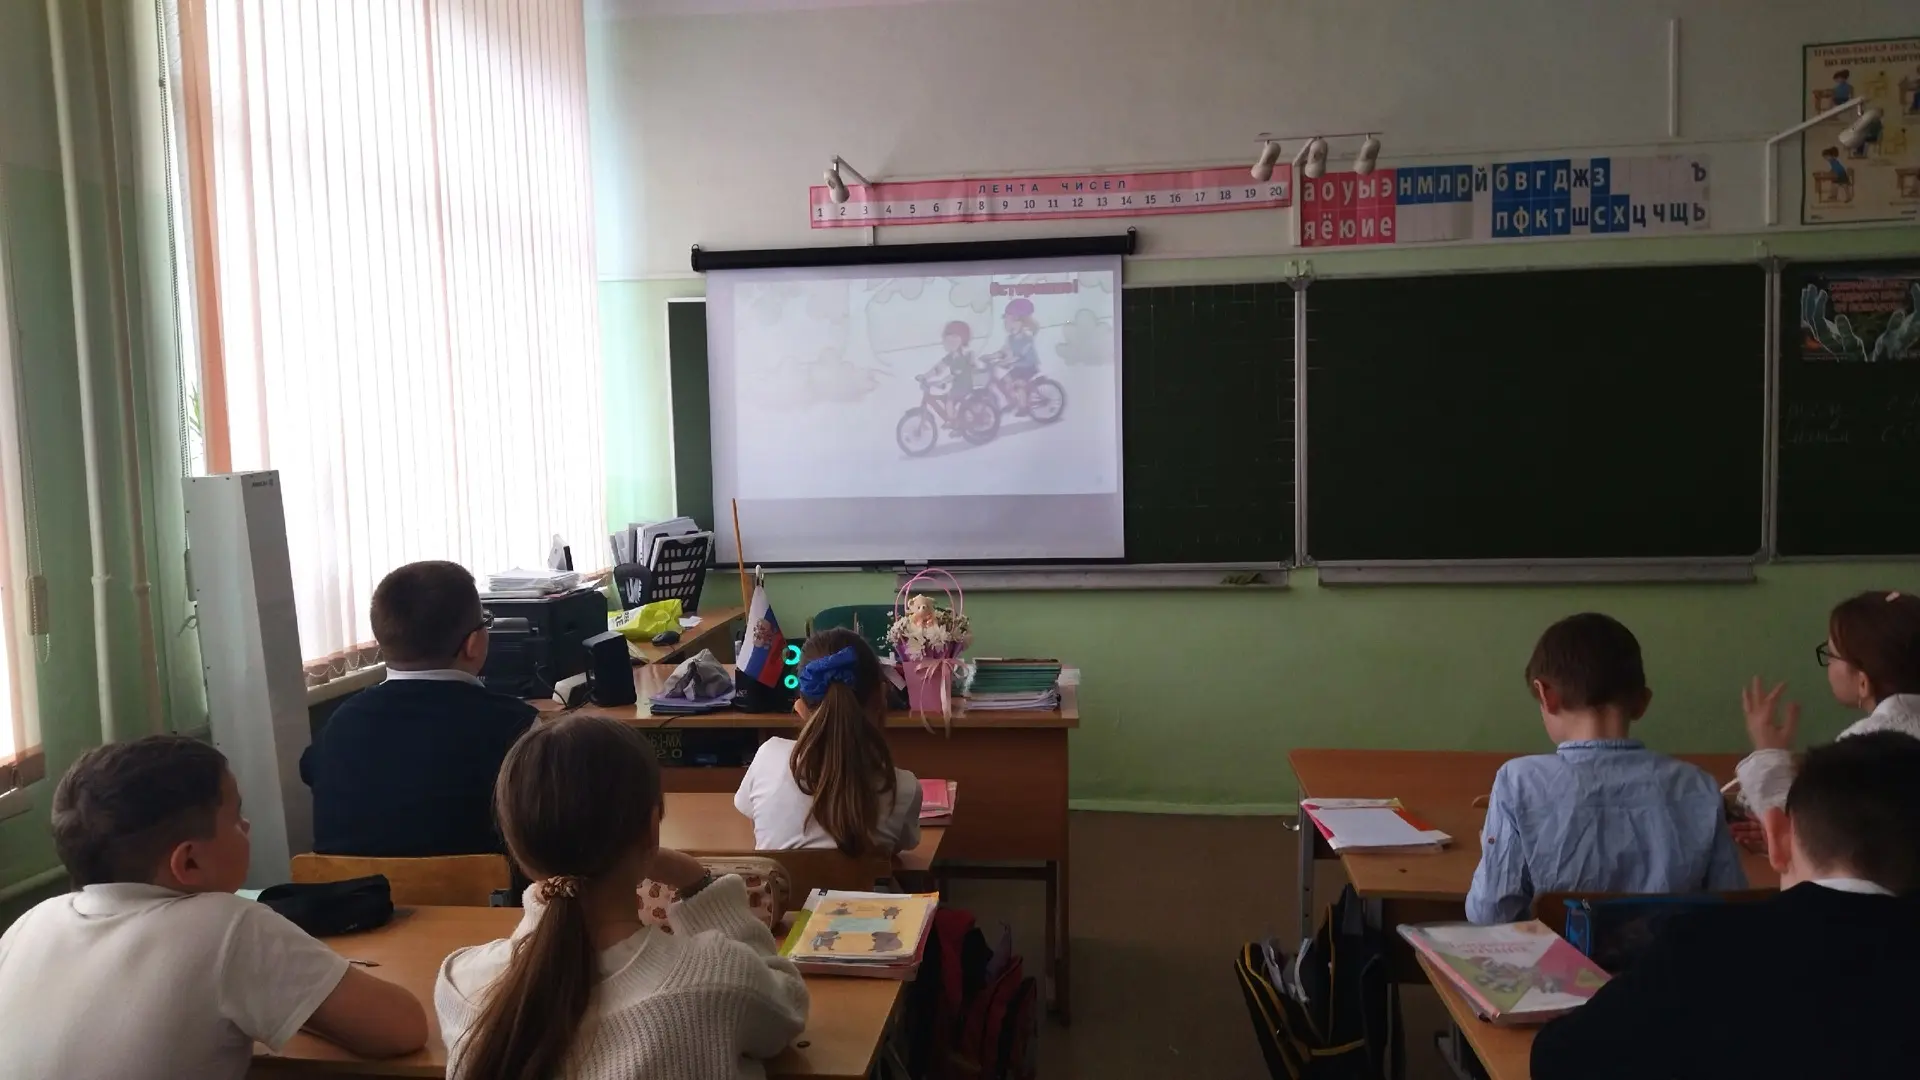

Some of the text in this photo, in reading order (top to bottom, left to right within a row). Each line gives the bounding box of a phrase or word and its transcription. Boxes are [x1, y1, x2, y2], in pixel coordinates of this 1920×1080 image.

[978, 181, 1126, 194] ЛЕНТА ЧИСЕЛ
[818, 186, 1282, 217] 1 2 3 4 5 6 7 8 9 10 11 12 13 14 15 16 17 18 19 20
